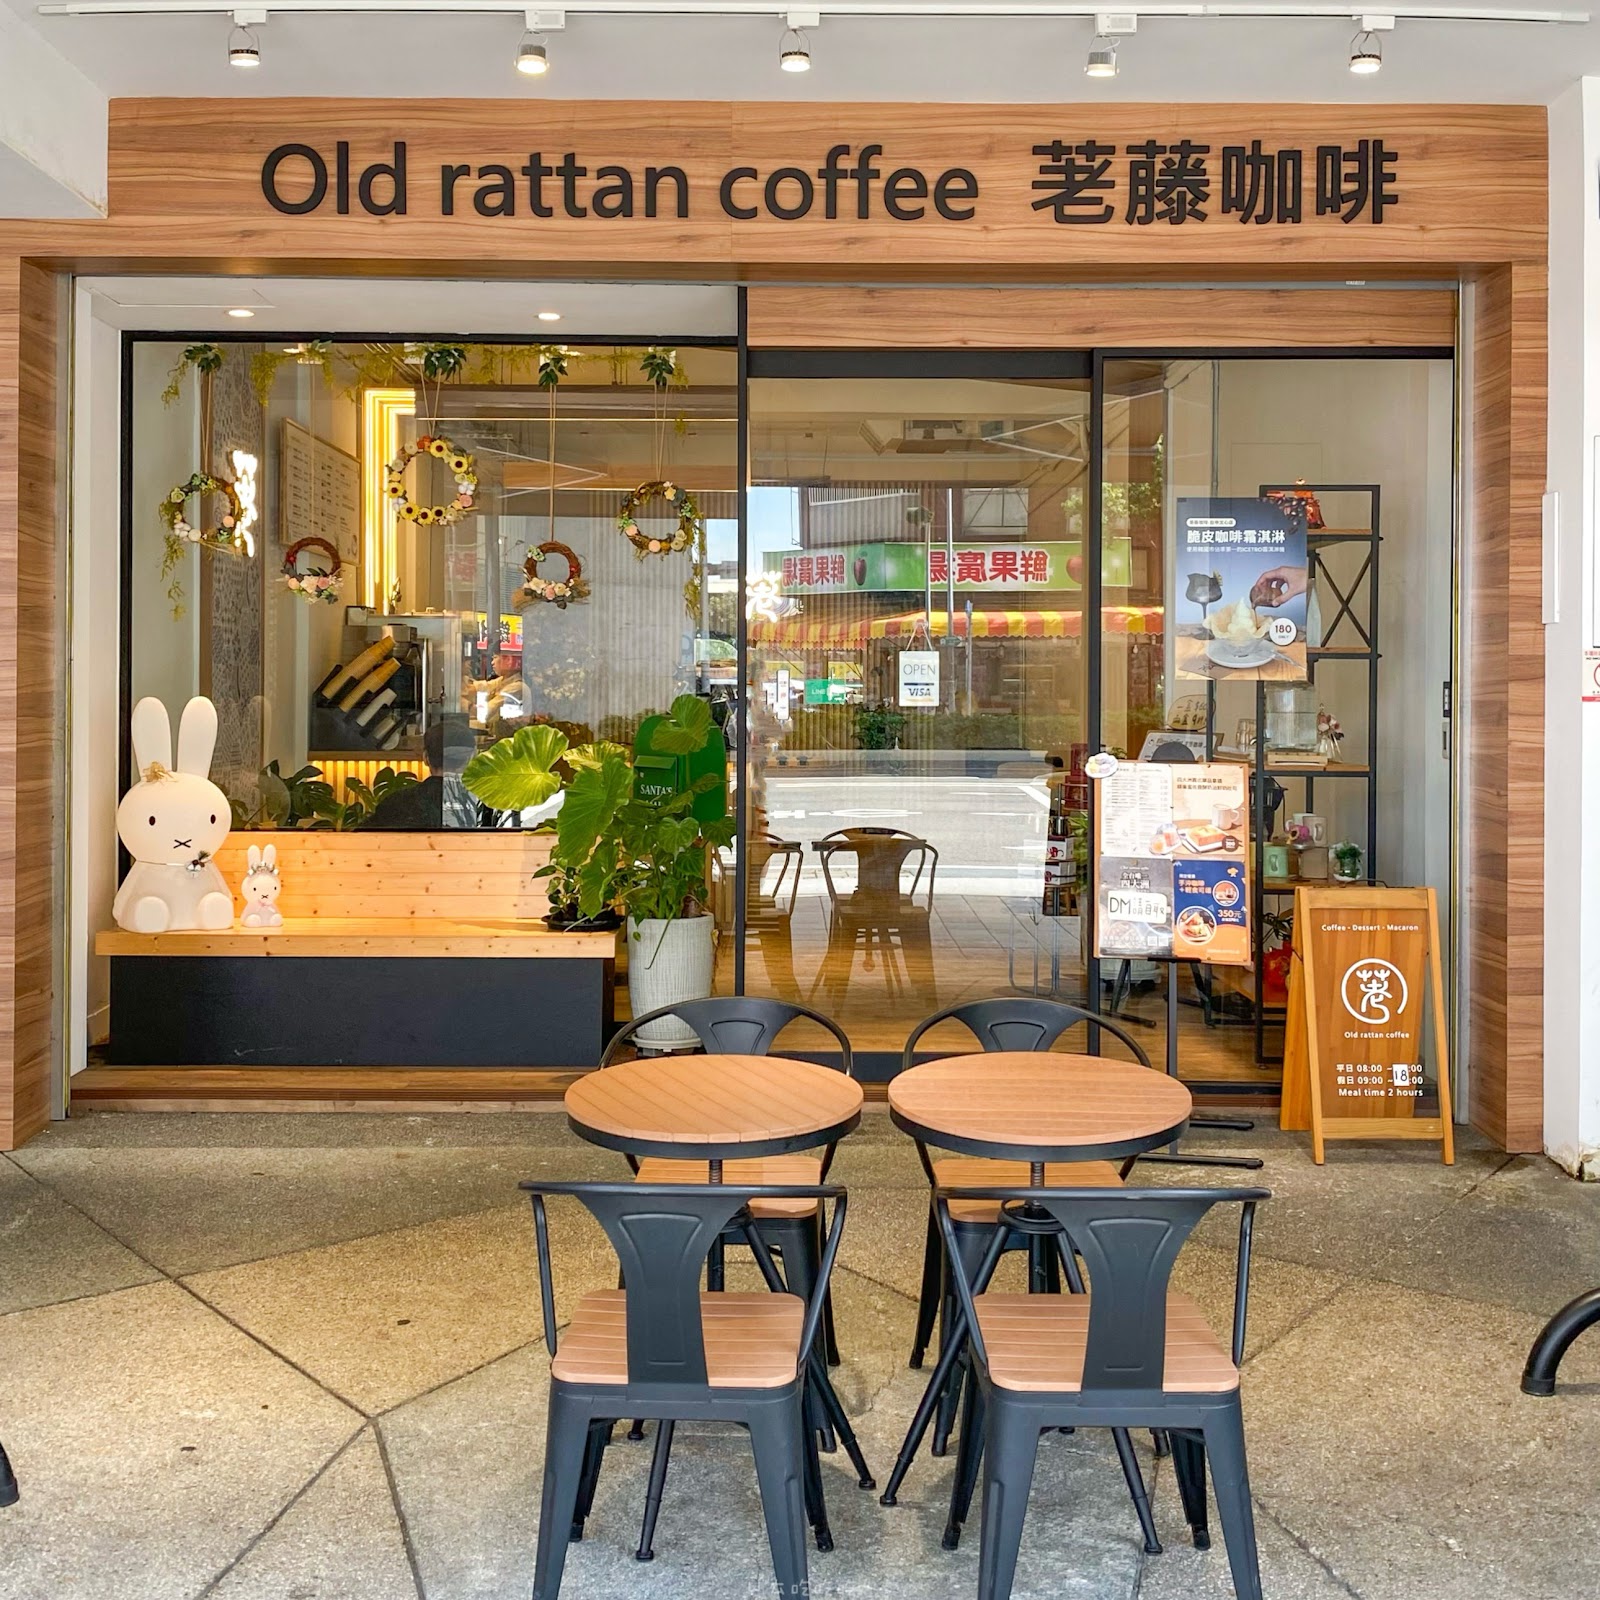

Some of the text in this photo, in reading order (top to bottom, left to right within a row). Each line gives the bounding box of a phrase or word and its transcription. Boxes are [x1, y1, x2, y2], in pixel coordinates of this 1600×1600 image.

[261, 140, 979, 221] Old rattan coffee
[1030, 139, 1399, 226] 荖藤咖啡
[1186, 529, 1286, 544] 脆皮咖啡霜淇淋
[1275, 624, 1292, 634] 180
[903, 663, 936, 676] OPEN
[908, 687, 931, 697] VISA
[640, 783, 673, 796] SANTA'S
[1321, 923, 1419, 932] Coffee Dessert Macaron
[1344, 1031, 1410, 1039] Old rattan coffee
[1336, 1064, 1354, 1073] 平日
[1356, 1064, 1383, 1073] 08:00
[1337, 1075, 1355, 1085] 假日
[1357, 1076, 1384, 1085] 09:00
[1338, 1088, 1424, 1097] Meal time 2 hours
